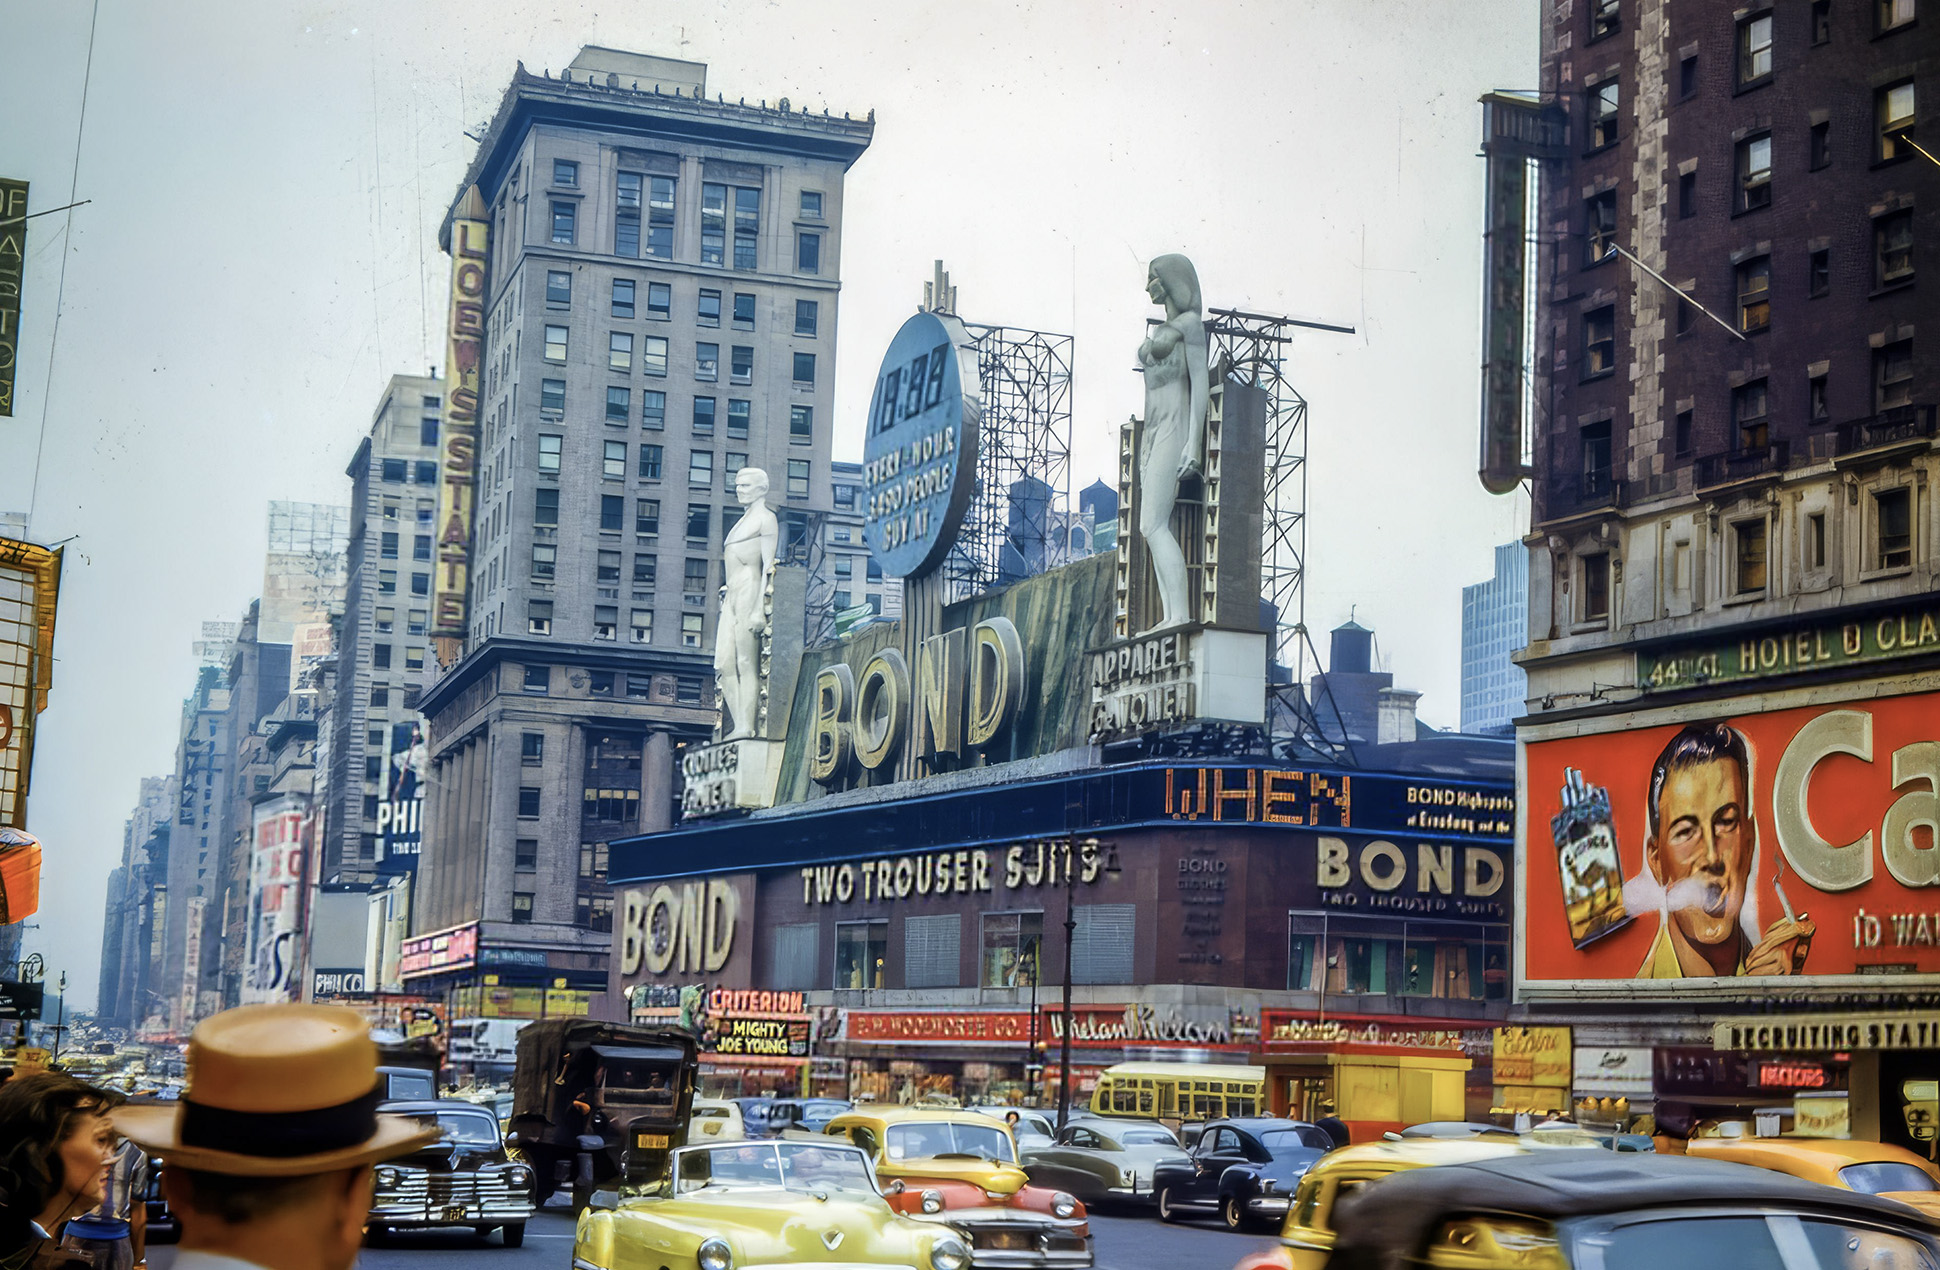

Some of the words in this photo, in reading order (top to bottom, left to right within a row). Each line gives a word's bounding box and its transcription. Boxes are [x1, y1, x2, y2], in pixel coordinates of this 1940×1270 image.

[437, 438, 475, 627] STATE
[1092, 633, 1187, 686] APPAREL
[1739, 629, 1831, 673] HOTEL
[811, 617, 1027, 783] BOND
[1165, 768, 1351, 827] WHEN
[1407, 787, 1455, 806] BOND
[801, 864, 854, 904] TWO
[861, 850, 991, 902] TROUSER
[1179, 858, 1227, 872] BOND
[1317, 837, 1505, 897] BOND
[621, 879, 738, 976] BOND
[717, 1037, 744, 1054] JOE
[745, 1037, 788, 1055] YOUNG
[732, 1020, 786, 1038] MIGHTY
[1731, 1023, 1859, 1048] RECRUITING
